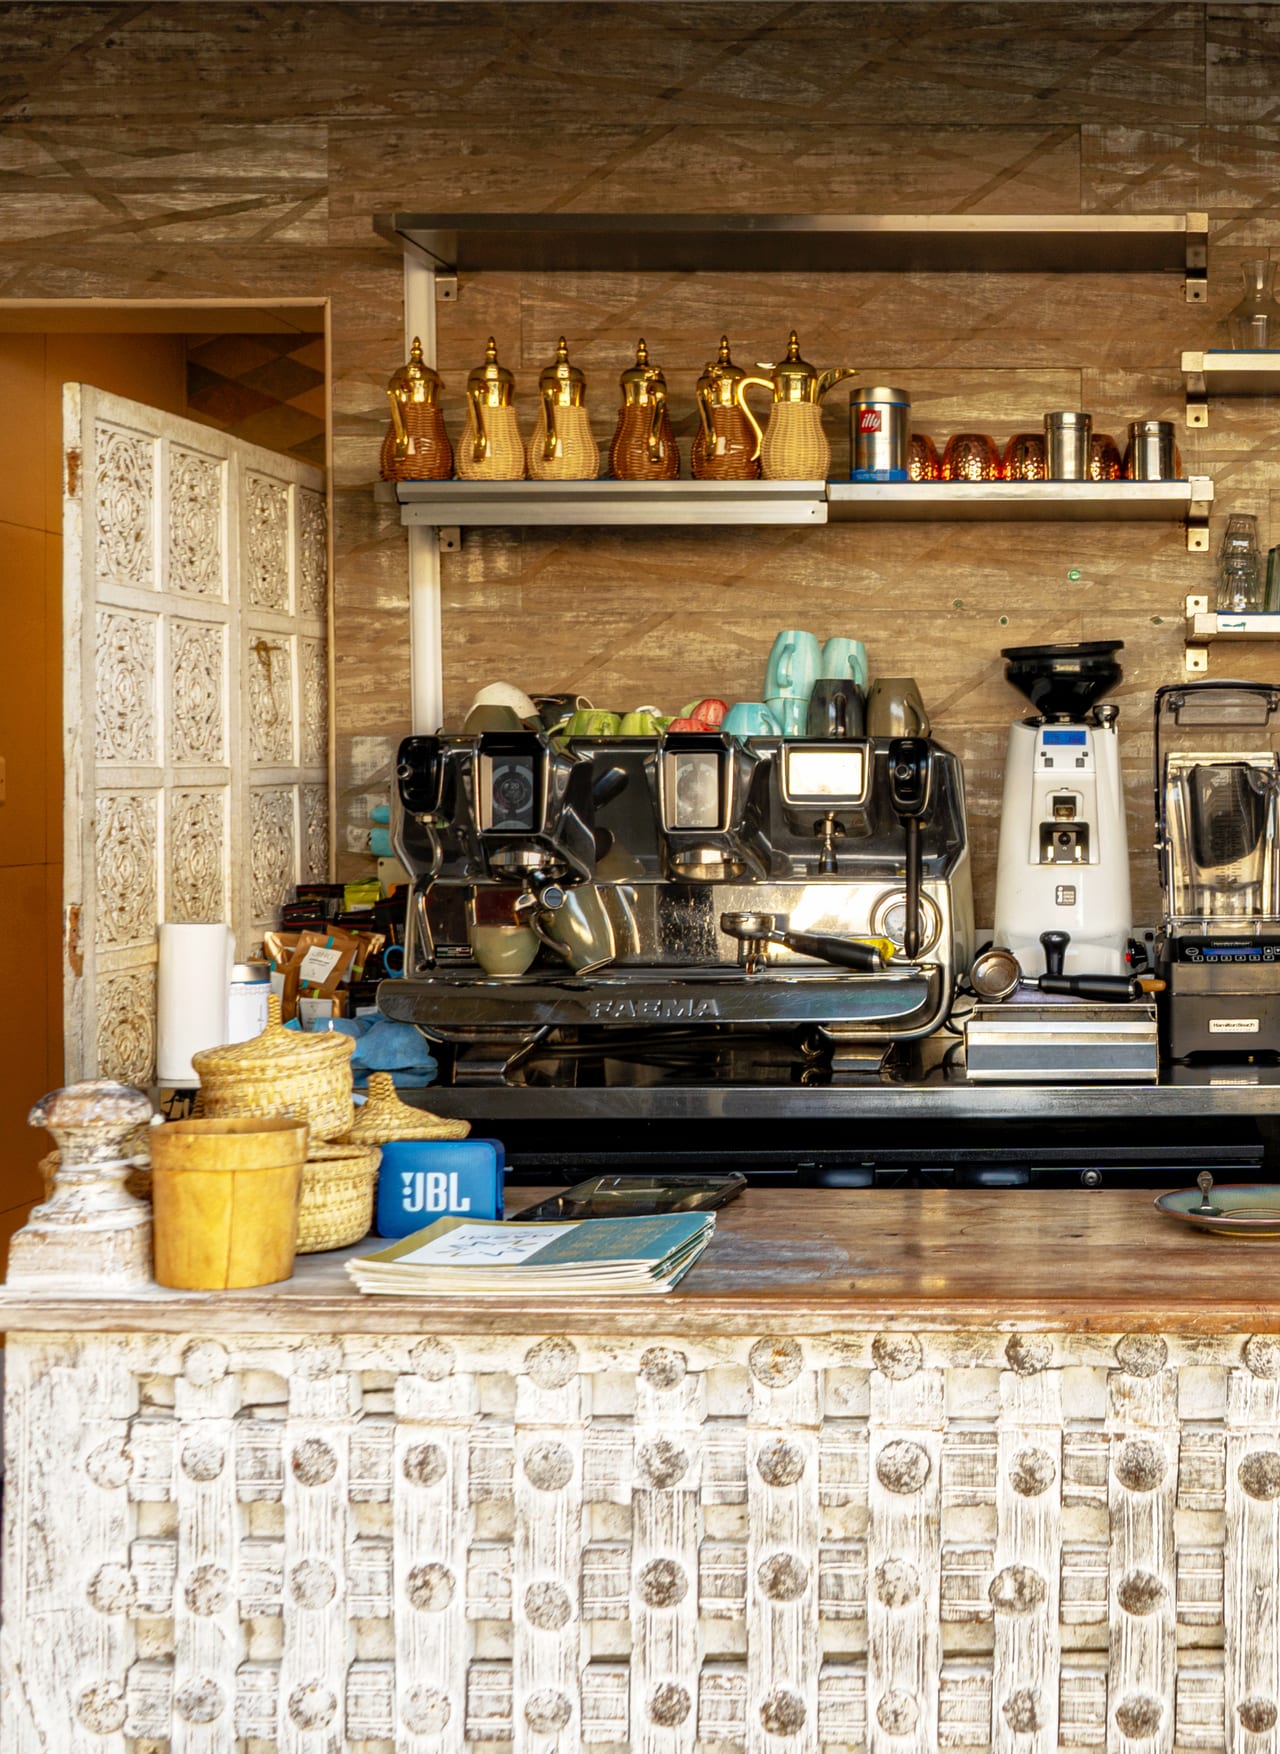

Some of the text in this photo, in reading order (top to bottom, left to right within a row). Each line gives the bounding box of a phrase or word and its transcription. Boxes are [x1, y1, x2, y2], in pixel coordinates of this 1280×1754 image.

[861, 412, 881, 431] illy
[591, 998, 720, 1018] FAEMA
[402, 1172, 471, 1213] JBL
